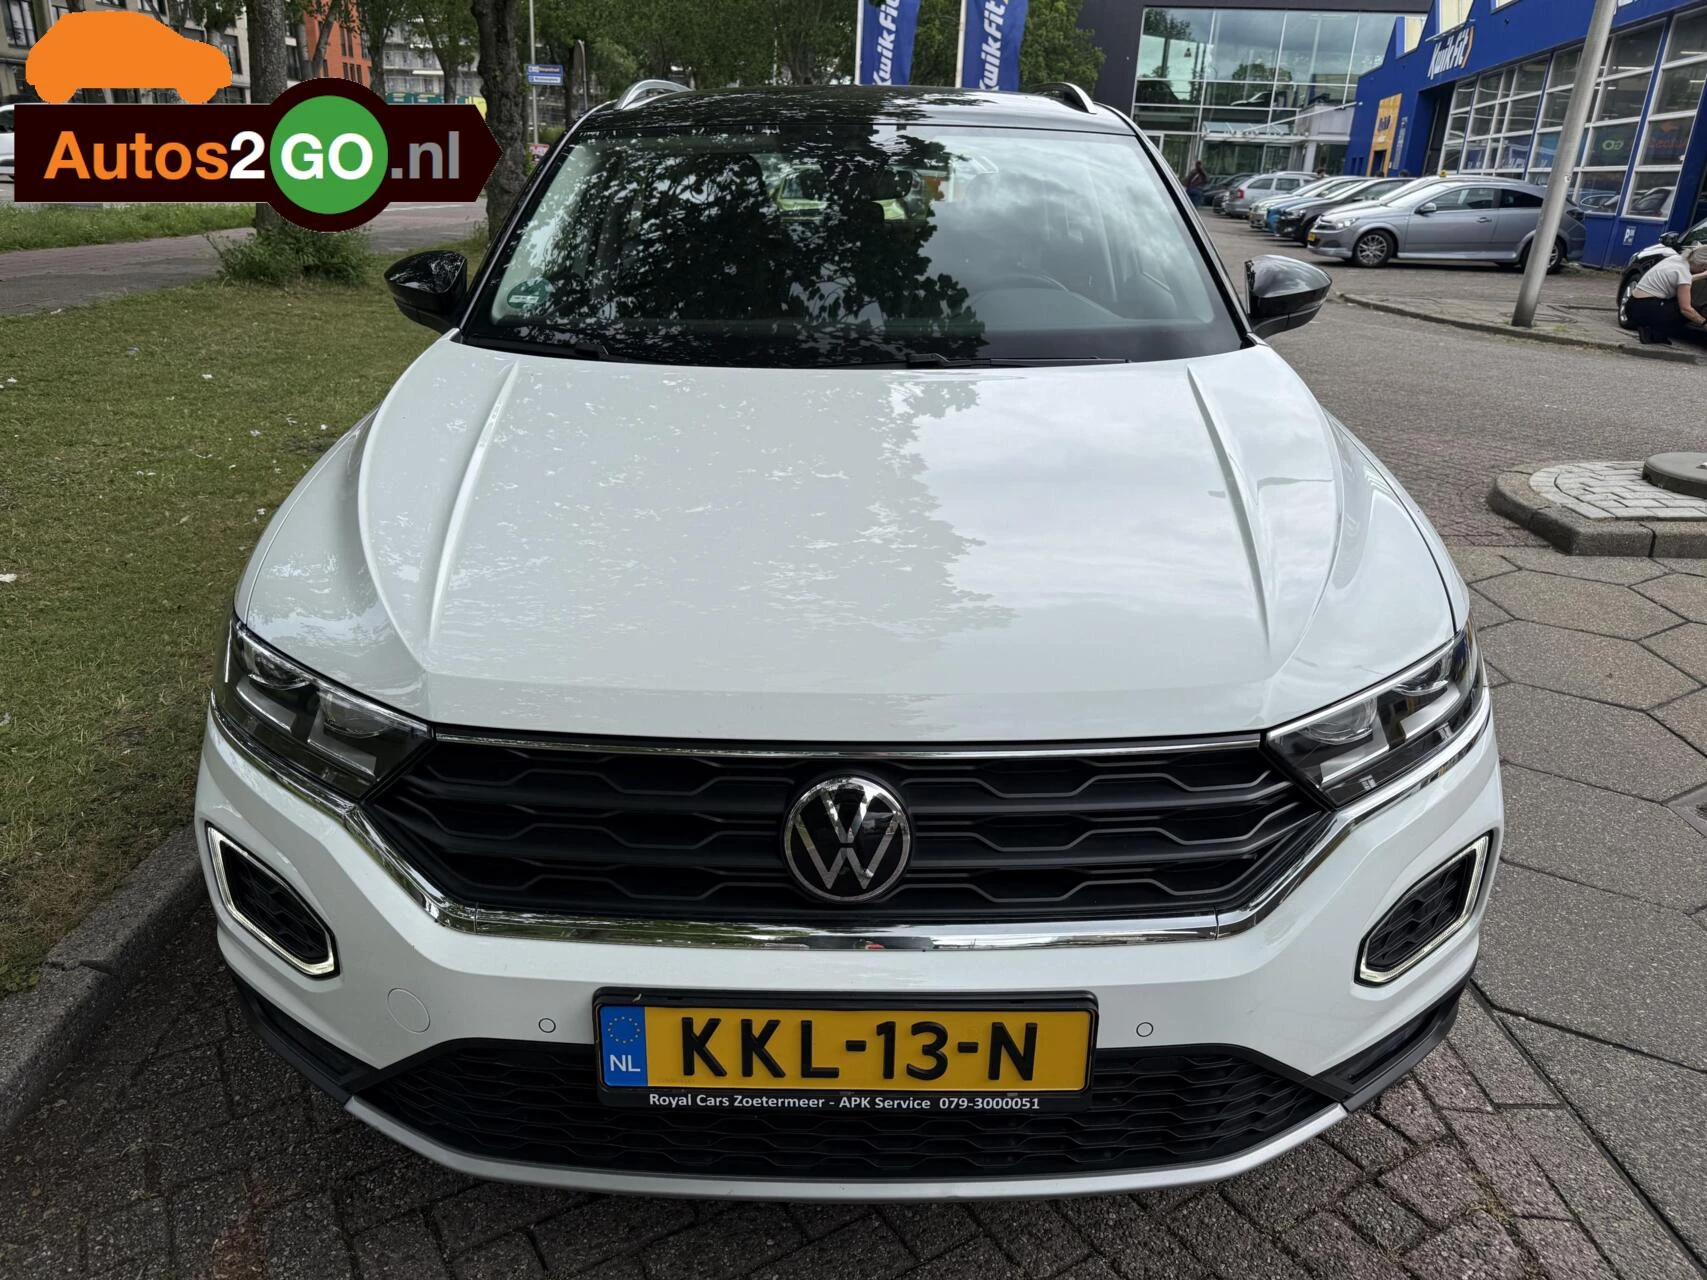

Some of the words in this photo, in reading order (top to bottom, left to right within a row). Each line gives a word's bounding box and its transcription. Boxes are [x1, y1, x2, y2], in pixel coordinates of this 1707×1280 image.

[681, 1016, 1039, 1081] KKL-13-N
[610, 1054, 641, 1073] NL
[649, 1093, 692, 1108] Royal
[696, 1094, 729, 1107] Cars
[734, 1095, 824, 1108] Zoetermeer
[839, 1096, 870, 1109] APK
[875, 1096, 931, 1109] Service
[939, 1097, 1040, 1110] 079-3000051
